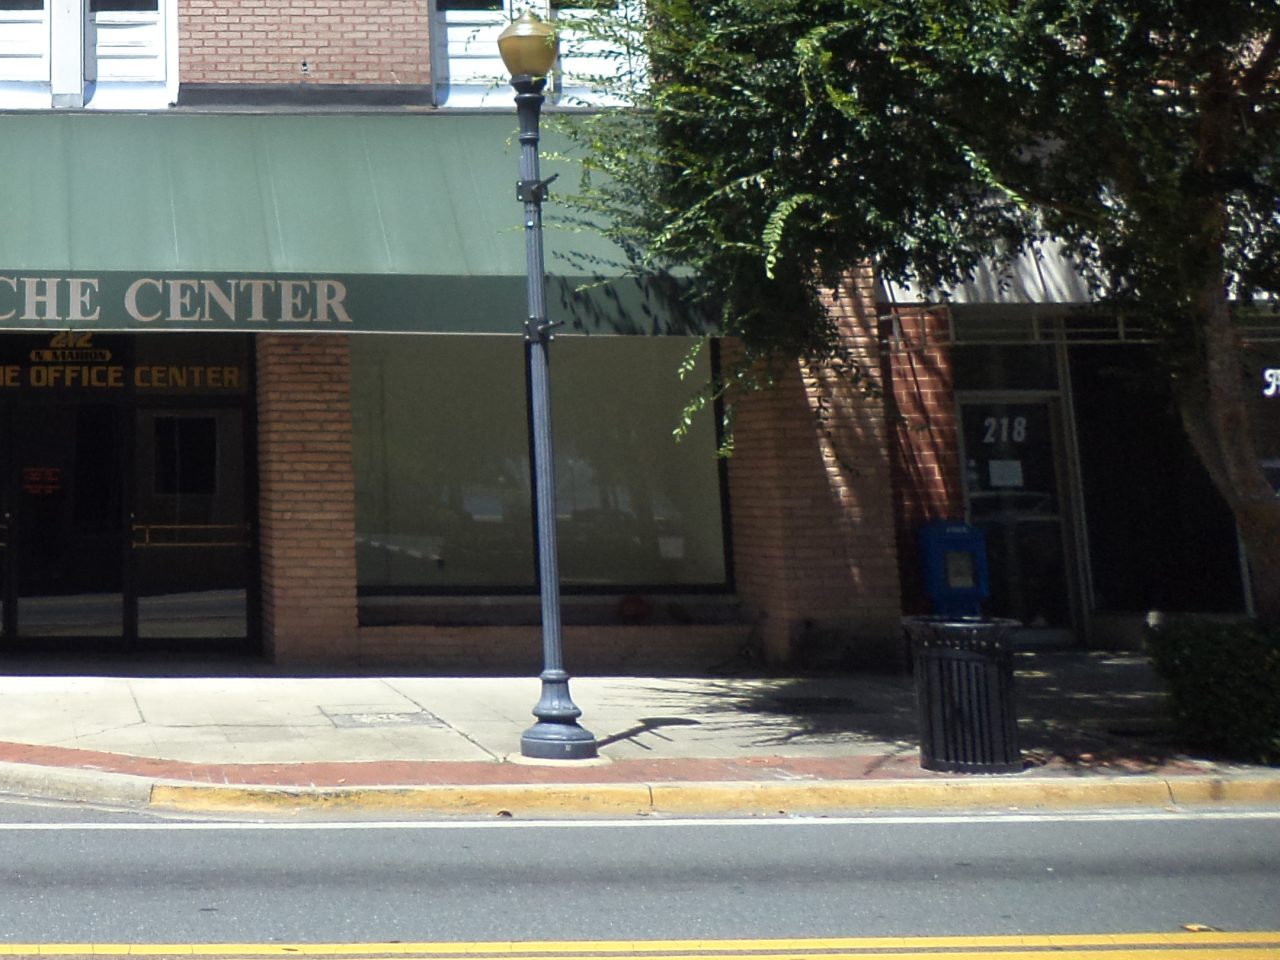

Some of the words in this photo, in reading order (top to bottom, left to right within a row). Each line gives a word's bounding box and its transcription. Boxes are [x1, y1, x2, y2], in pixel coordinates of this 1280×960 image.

[124, 278, 353, 323] CENTER
[30, 365, 123, 388] OFFICE
[134, 365, 240, 387] CENTER
[983, 417, 1027, 443] 218
